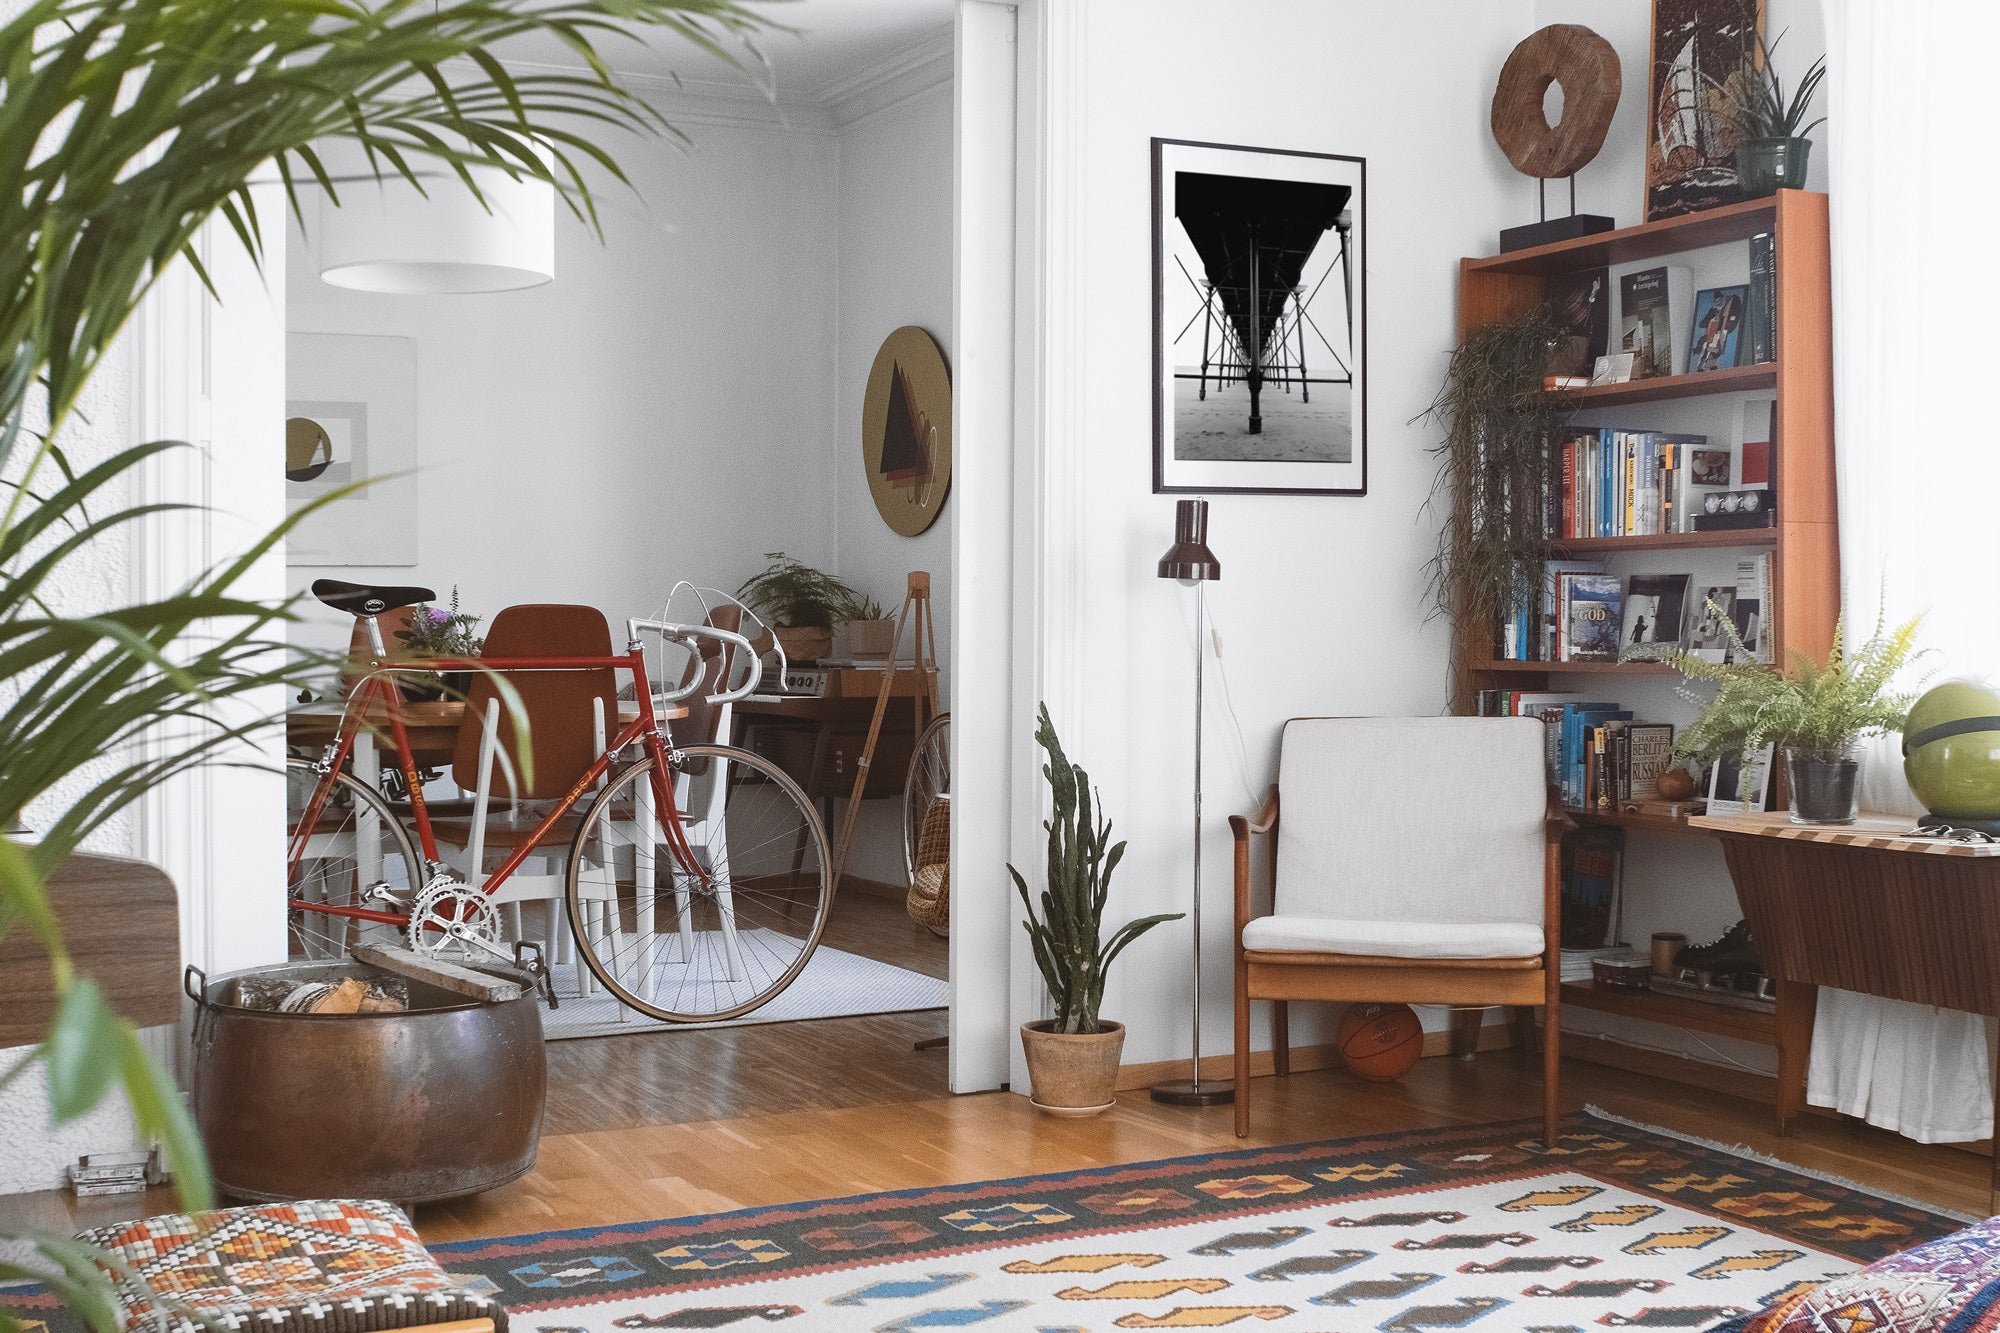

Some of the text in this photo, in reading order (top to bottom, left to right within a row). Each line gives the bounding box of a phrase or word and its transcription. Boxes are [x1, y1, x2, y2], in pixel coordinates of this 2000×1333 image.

[1562, 448, 1571, 485] HARPER LEE
[1627, 488, 1635, 508] MOCK
[1578, 609, 1606, 621] GOD
[1632, 735, 1670, 744] CHARLES
[1632, 743, 1669, 756] BERLITZ
[407, 771, 424, 806] DBS
[565, 780, 589, 804] DBS
